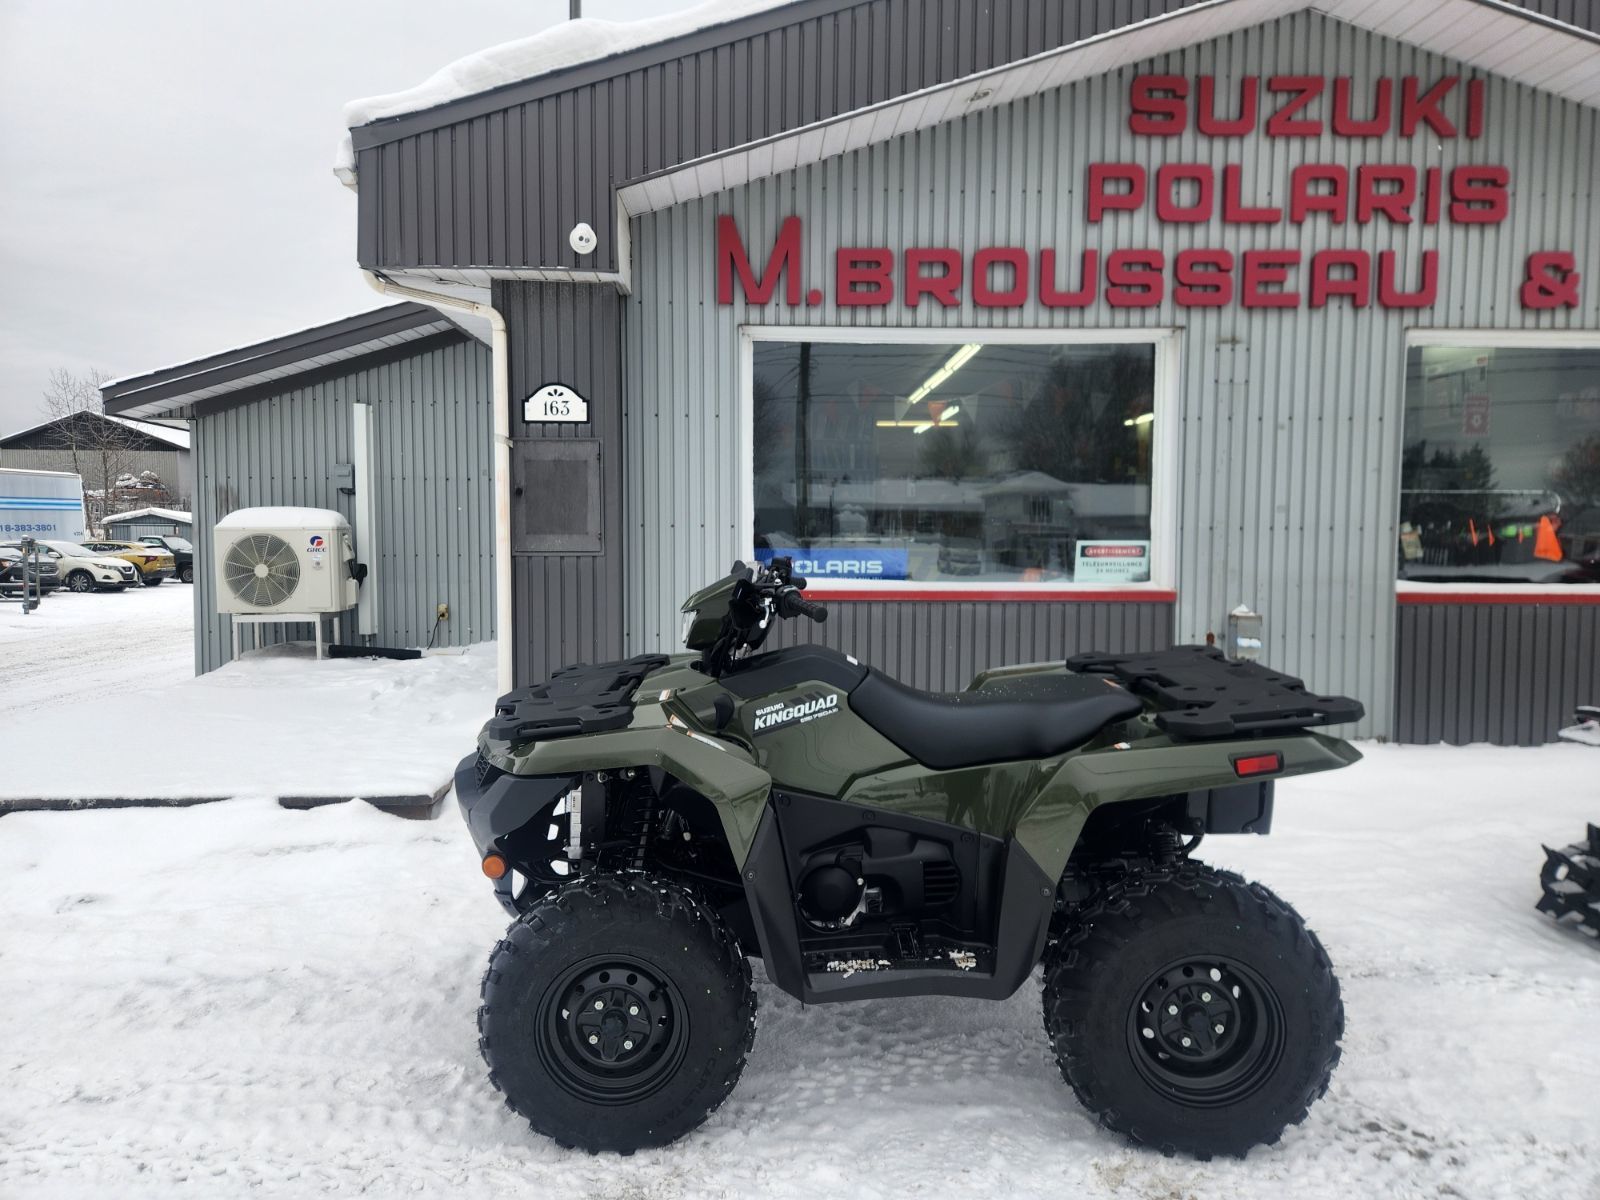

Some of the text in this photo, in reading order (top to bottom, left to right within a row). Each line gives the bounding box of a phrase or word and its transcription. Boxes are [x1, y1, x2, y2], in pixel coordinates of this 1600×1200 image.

[1131, 75, 1482, 137] SUZUKI
[1088, 163, 1508, 224] POLARIS
[1521, 251, 1580, 309] &
[543, 400, 570, 416] 163
[791, 559, 884, 574] OLARIS
[754, 693, 838, 731] KINGQUAD
[755, 702, 785, 716] SUZUKI
